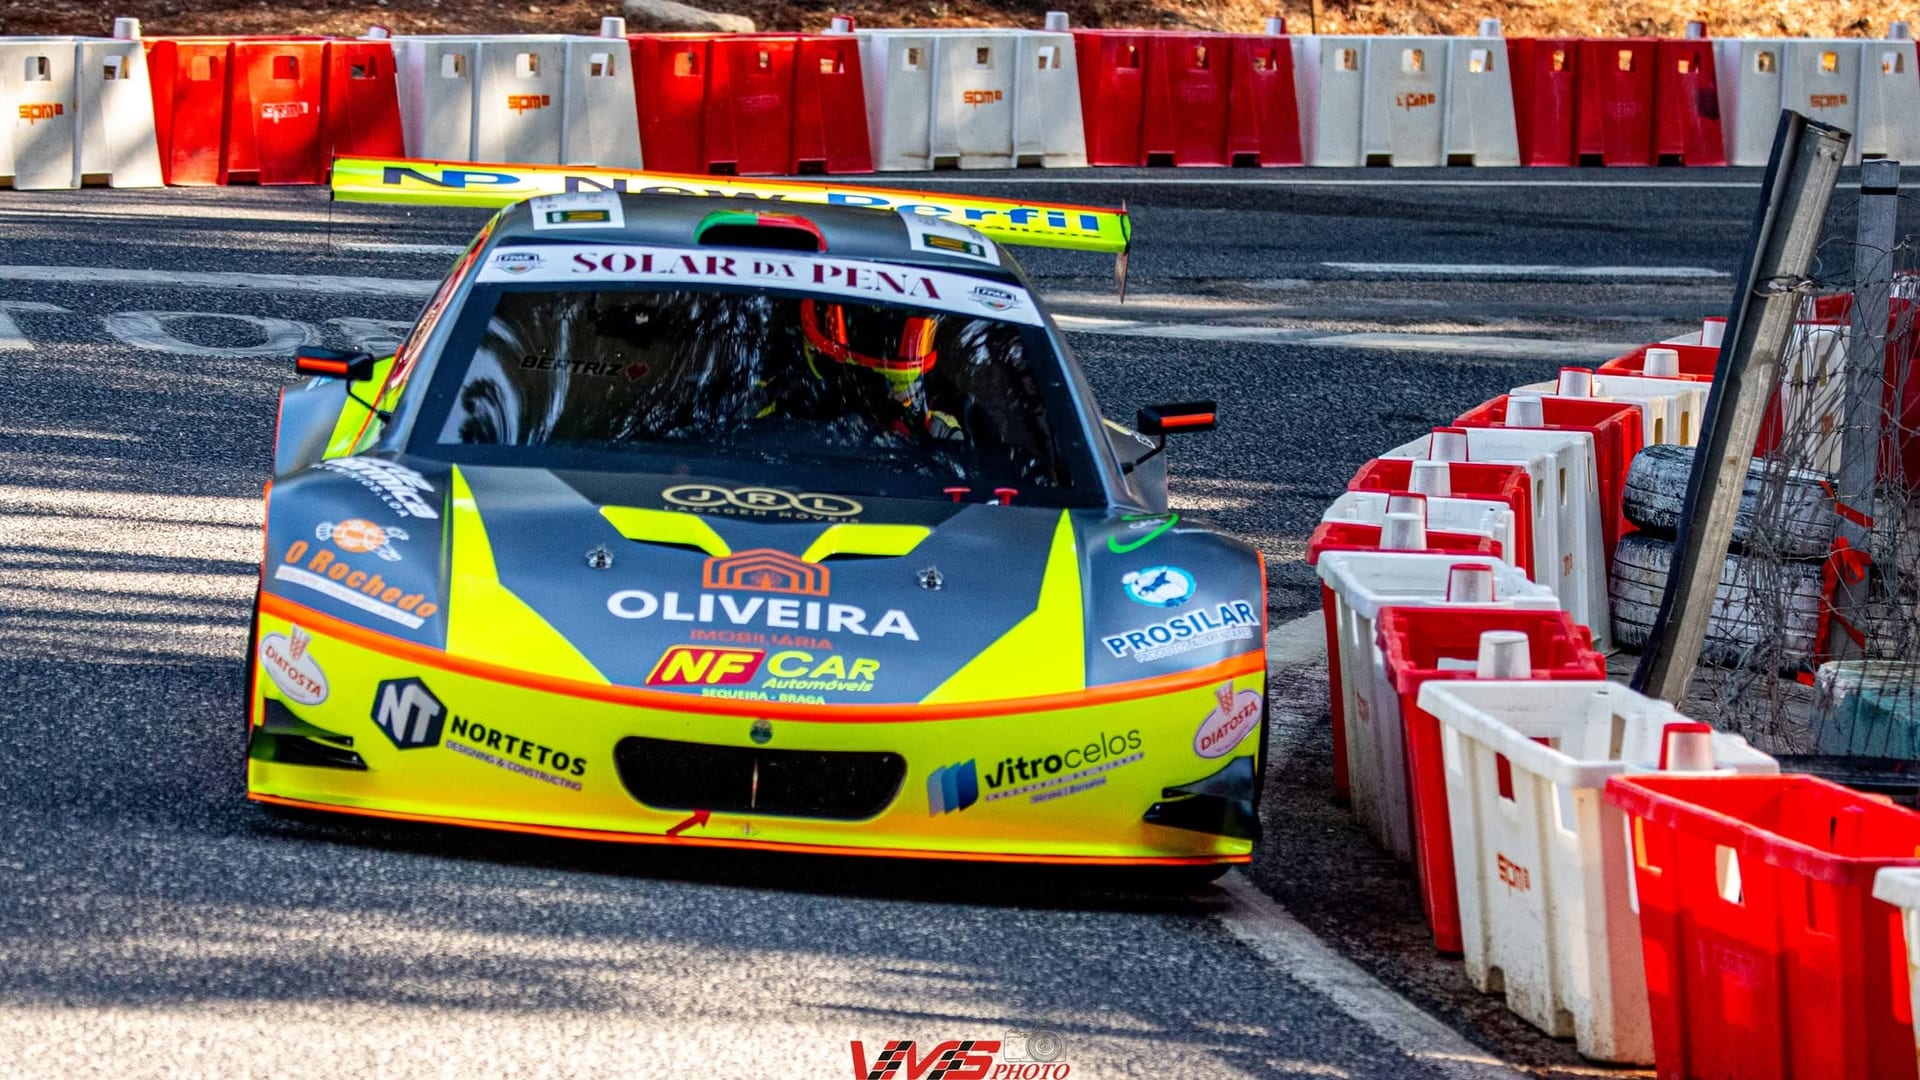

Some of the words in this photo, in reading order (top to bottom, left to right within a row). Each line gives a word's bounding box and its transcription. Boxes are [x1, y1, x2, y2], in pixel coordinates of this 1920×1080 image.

[383, 167, 520, 188] NP
[571, 252, 738, 277] SOLAR
[754, 261, 795, 278] DA
[812, 264, 942, 299] PENA
[284, 540, 309, 564] O
[307, 549, 438, 618] Rochedo
[606, 589, 920, 641] OLIVEIRA
[1106, 602, 1256, 655] PROSILAR
[661, 650, 755, 684] NF
[766, 650, 881, 681] CAR
[761, 677, 874, 693] Automóveis
[377, 683, 441, 743] NT
[701, 688, 769, 701] SEQUEIRA
[779, 693, 826, 705] BRAGA
[449, 715, 588, 777] NORTETOS
[1200, 700, 1258, 752] DIATOSTA
